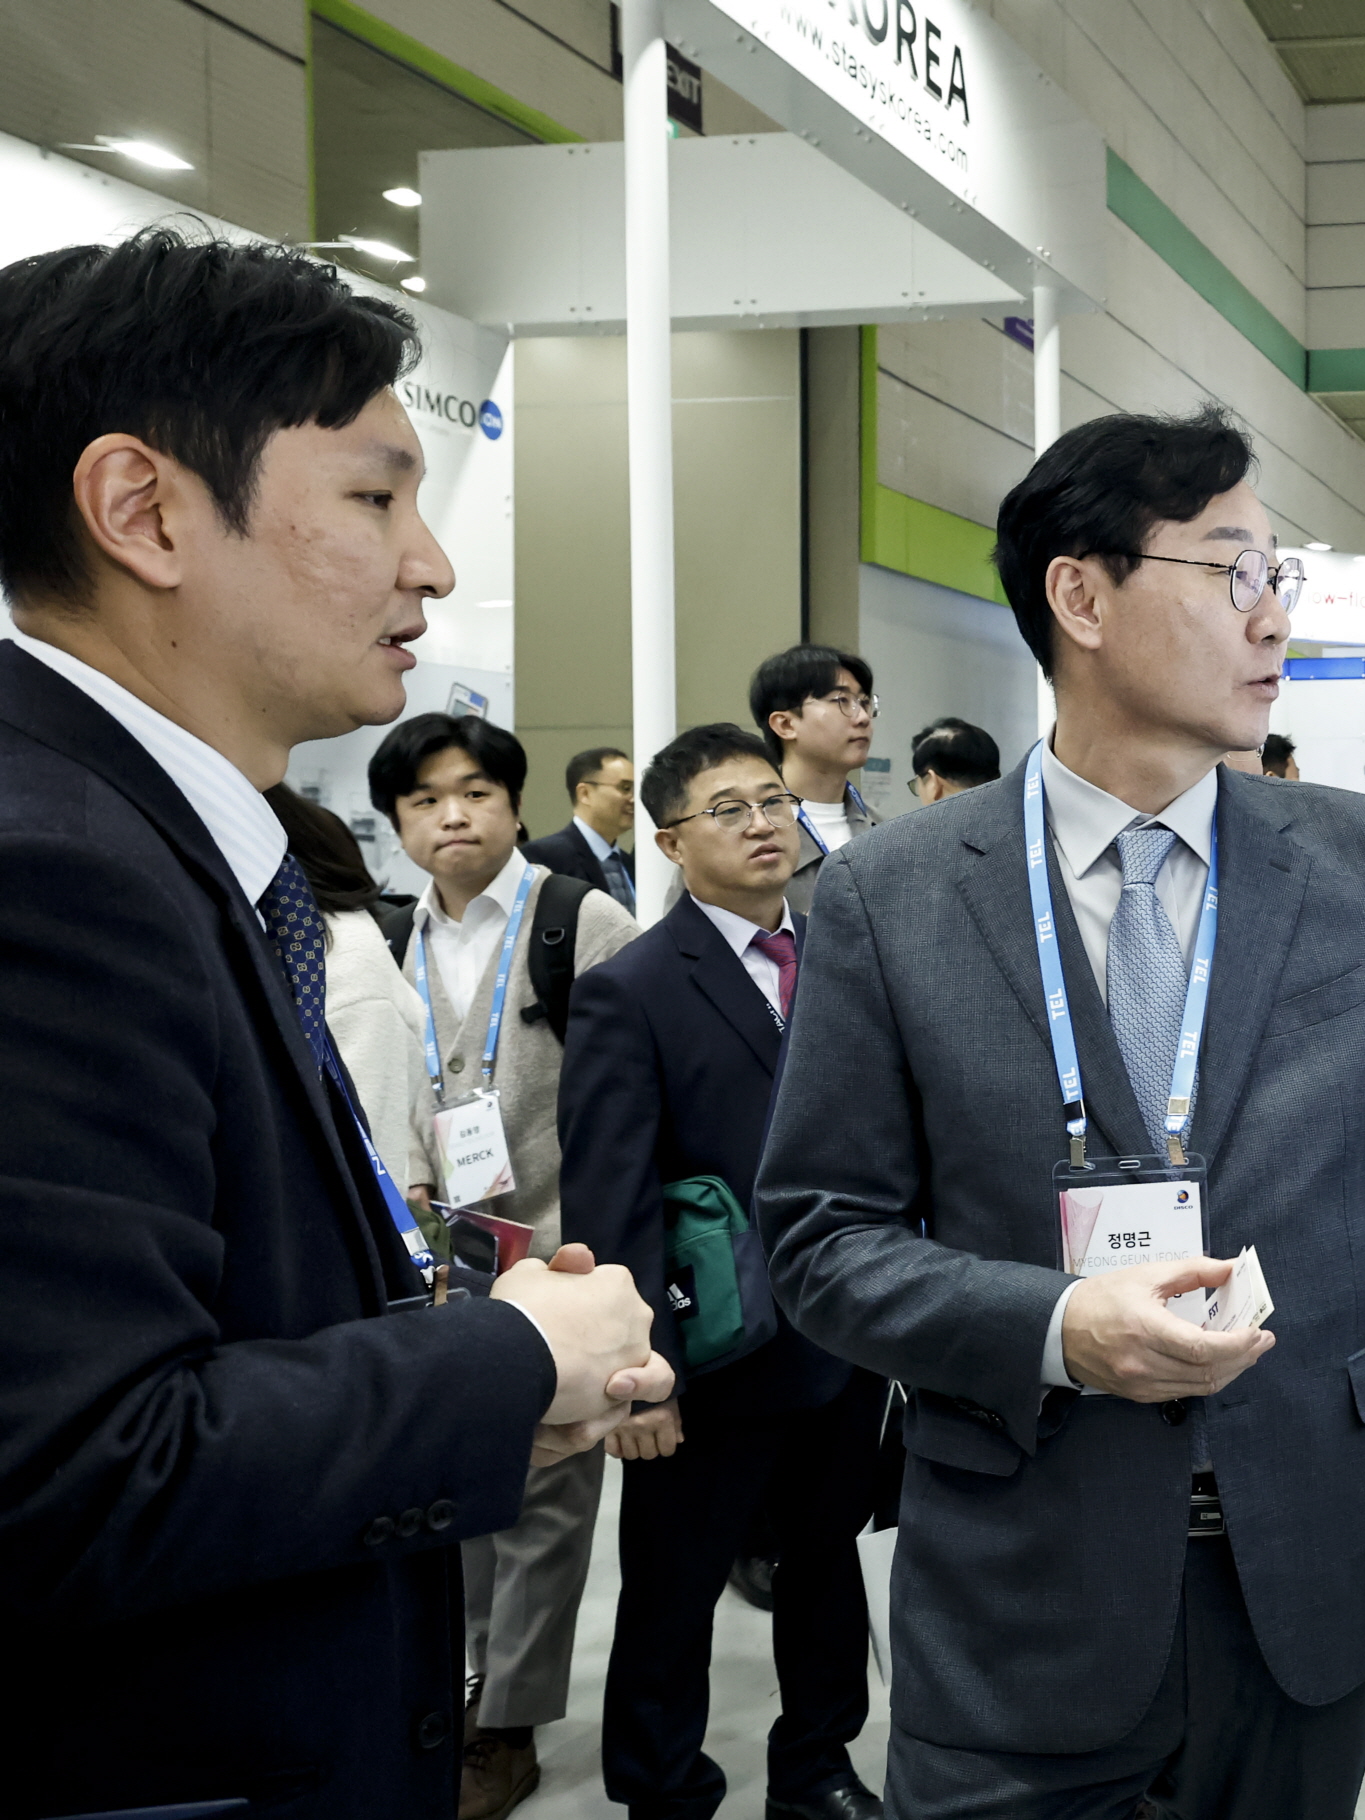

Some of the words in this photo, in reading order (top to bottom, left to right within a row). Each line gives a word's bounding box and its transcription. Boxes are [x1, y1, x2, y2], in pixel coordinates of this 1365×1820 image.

[826, 0, 969, 125] OREA
[404, 382, 477, 428] SIMCO
[1027, 772, 1041, 799] TEL
[1029, 838, 1043, 869] TEL
[1037, 911, 1053, 943] TEL
[504, 934, 515, 950] TEL
[496, 973, 506, 988] TEL
[1193, 957, 1209, 984] TEL
[1049, 988, 1066, 1020] TEL
[1180, 1031, 1198, 1058] TEL
[1062, 1067, 1079, 1101] TEL
[456, 1148, 494, 1167] MERCK
[1108, 1231, 1152, 1249] 정명근
[1120, 1253, 1150, 1266] GEUN
[1208, 1301, 1219, 1320] FST
